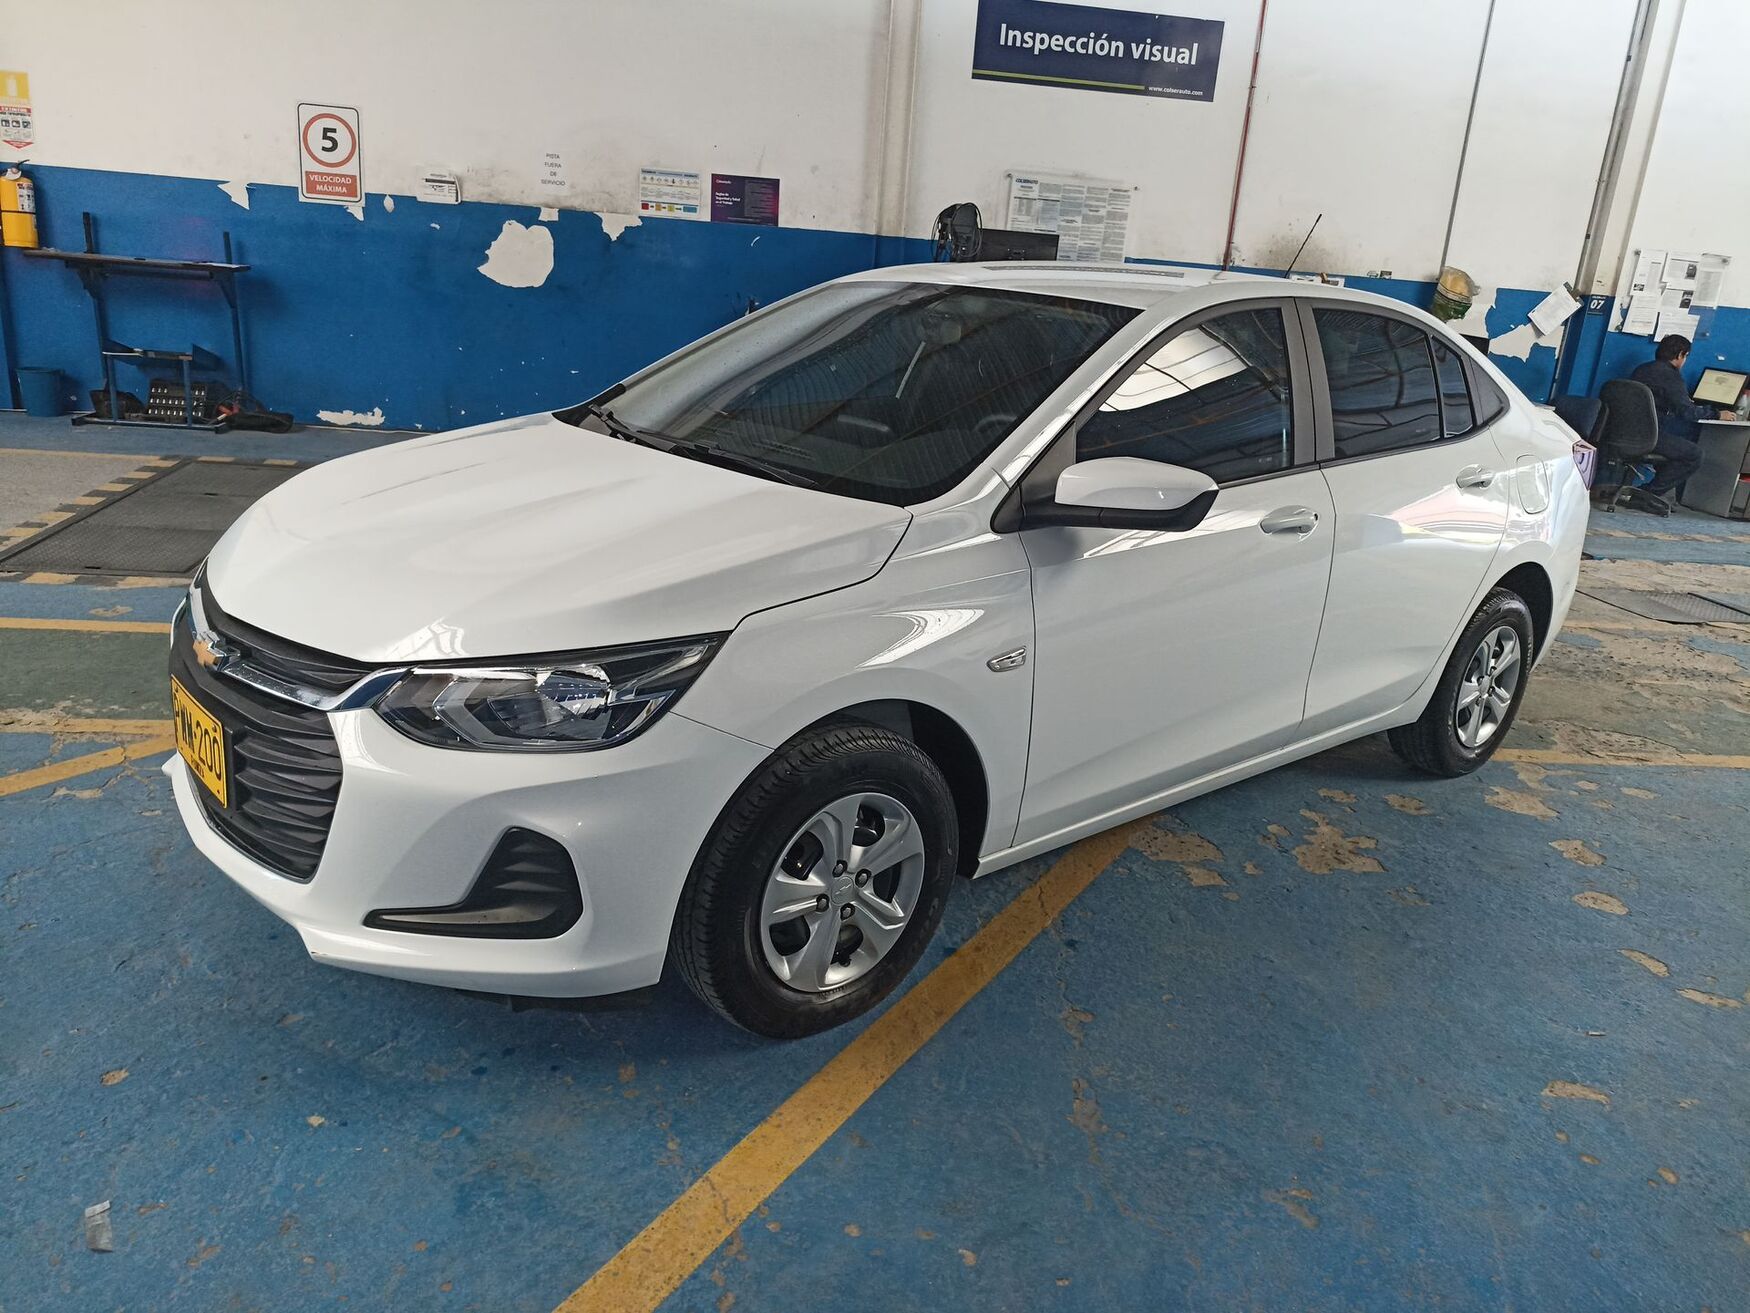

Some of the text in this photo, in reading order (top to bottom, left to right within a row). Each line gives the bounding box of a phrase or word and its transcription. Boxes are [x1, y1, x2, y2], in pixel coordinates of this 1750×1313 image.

[999, 23, 1199, 66] Inspección visual
[1148, 86, 1203, 96] www.colserauto.com
[321, 127, 339, 153] 5
[309, 174, 352, 184] VELOCIDAD
[316, 183, 347, 193] MÁXIMA
[1590, 299, 1605, 310] 07
